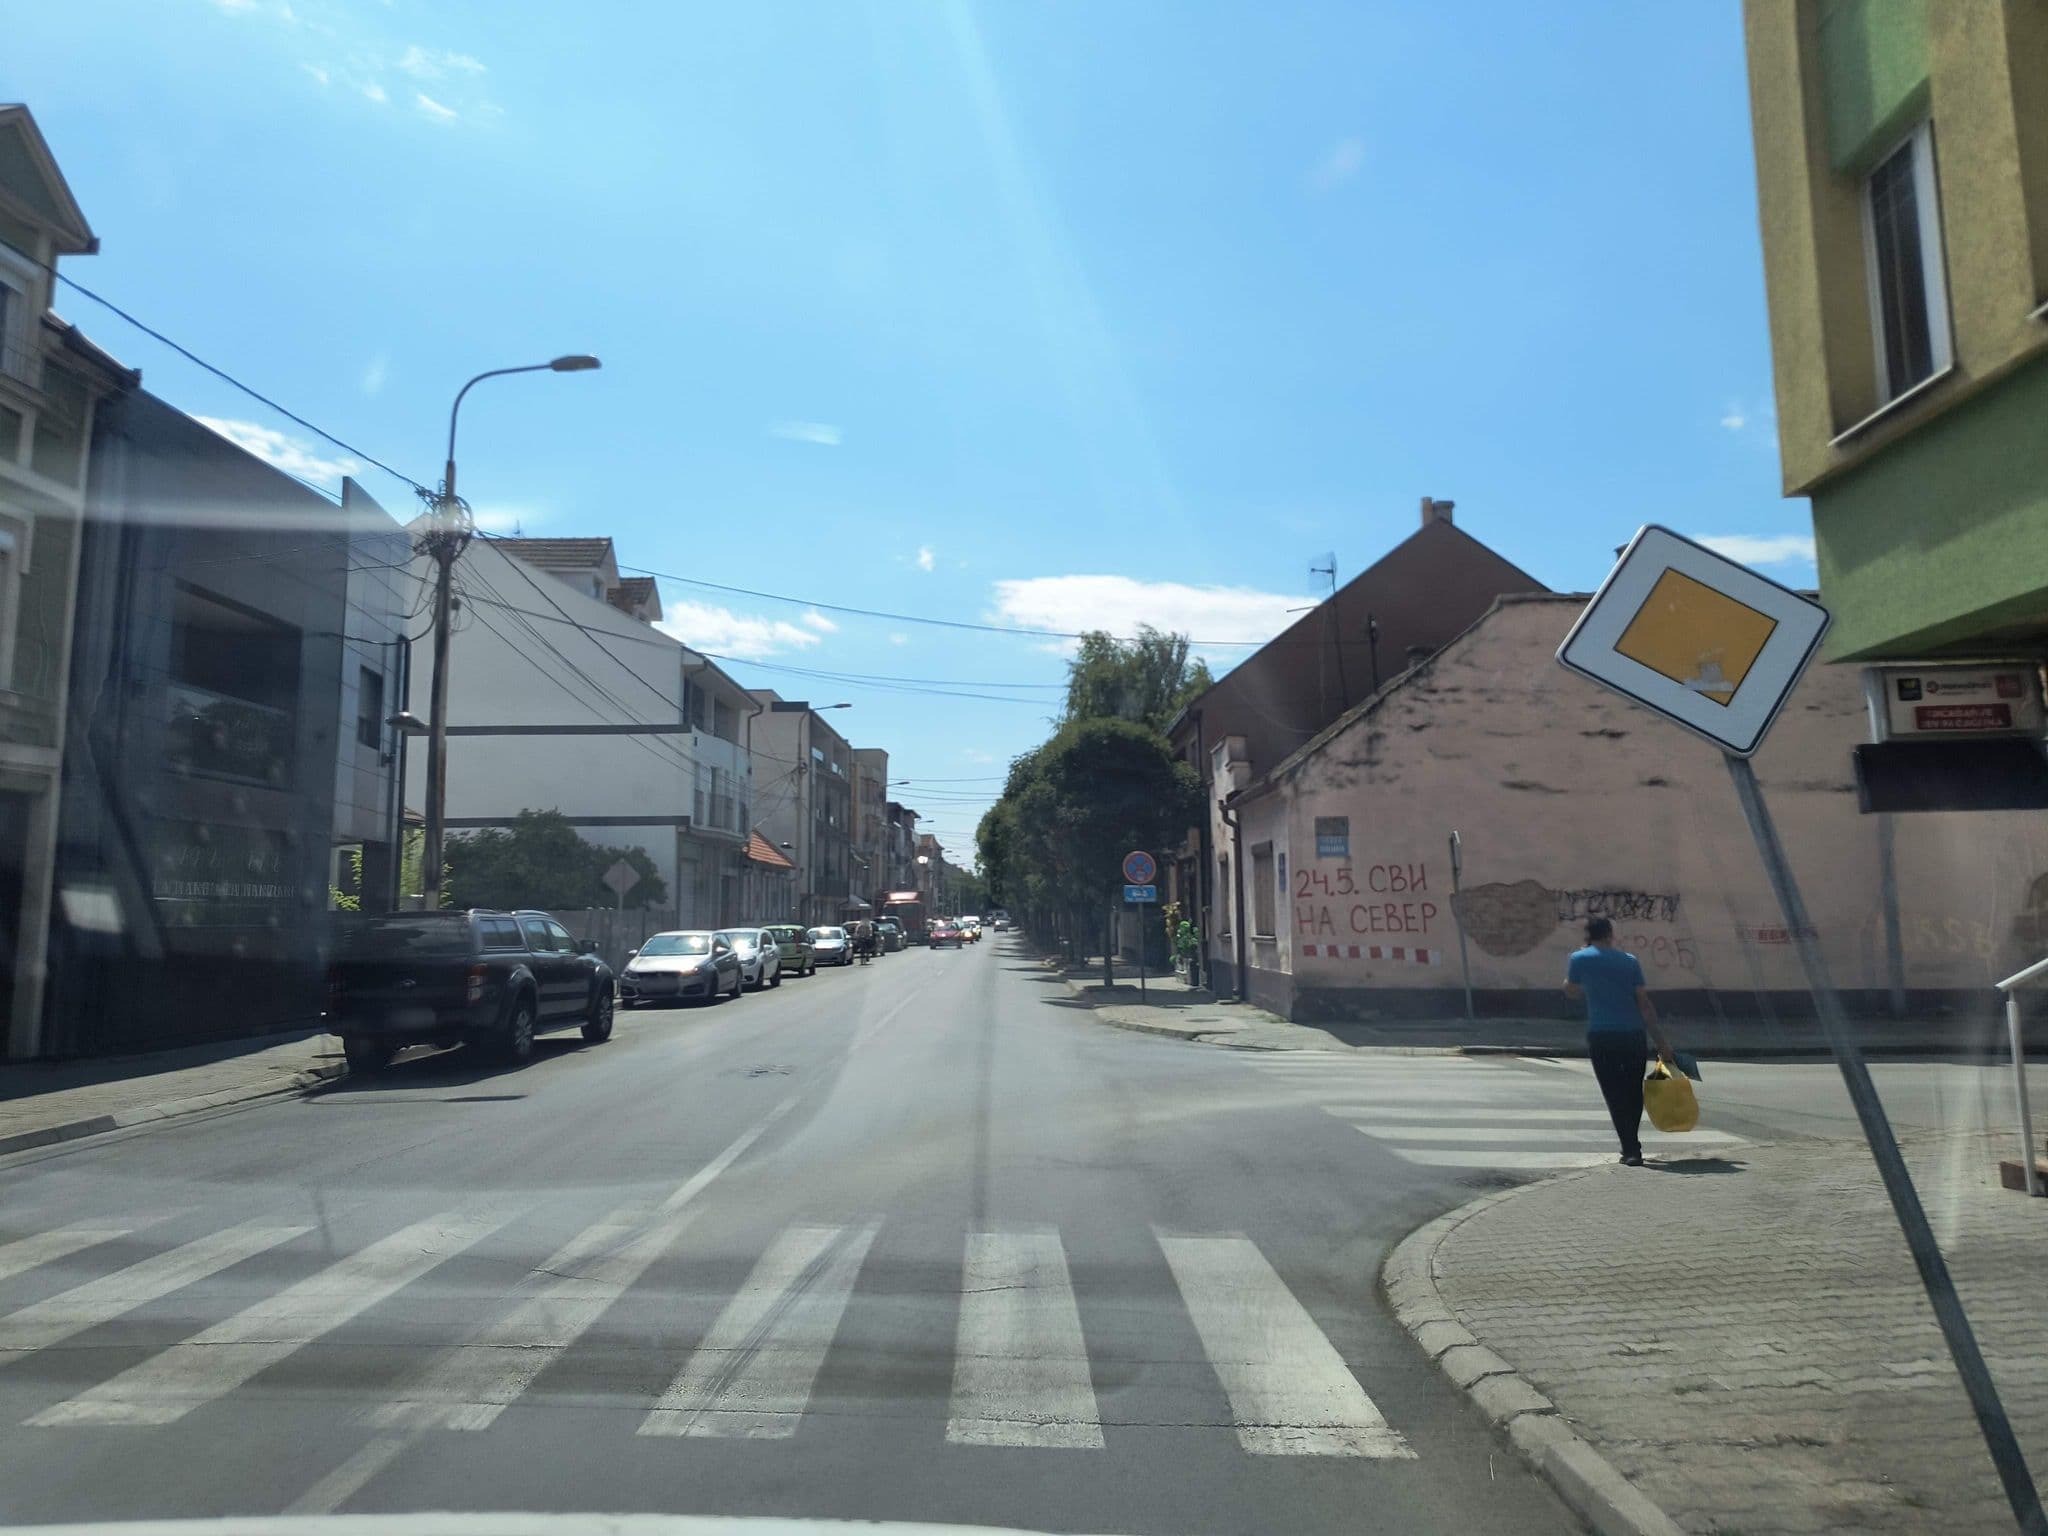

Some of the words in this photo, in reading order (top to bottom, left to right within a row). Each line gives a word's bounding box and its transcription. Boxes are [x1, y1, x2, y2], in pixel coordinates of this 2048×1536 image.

[1295, 867, 1360, 899] 24.5.
[1368, 863, 1429, 893] СВИ
[1296, 904, 1337, 936] НА
[1350, 902, 1438, 935] СЕВЕР
